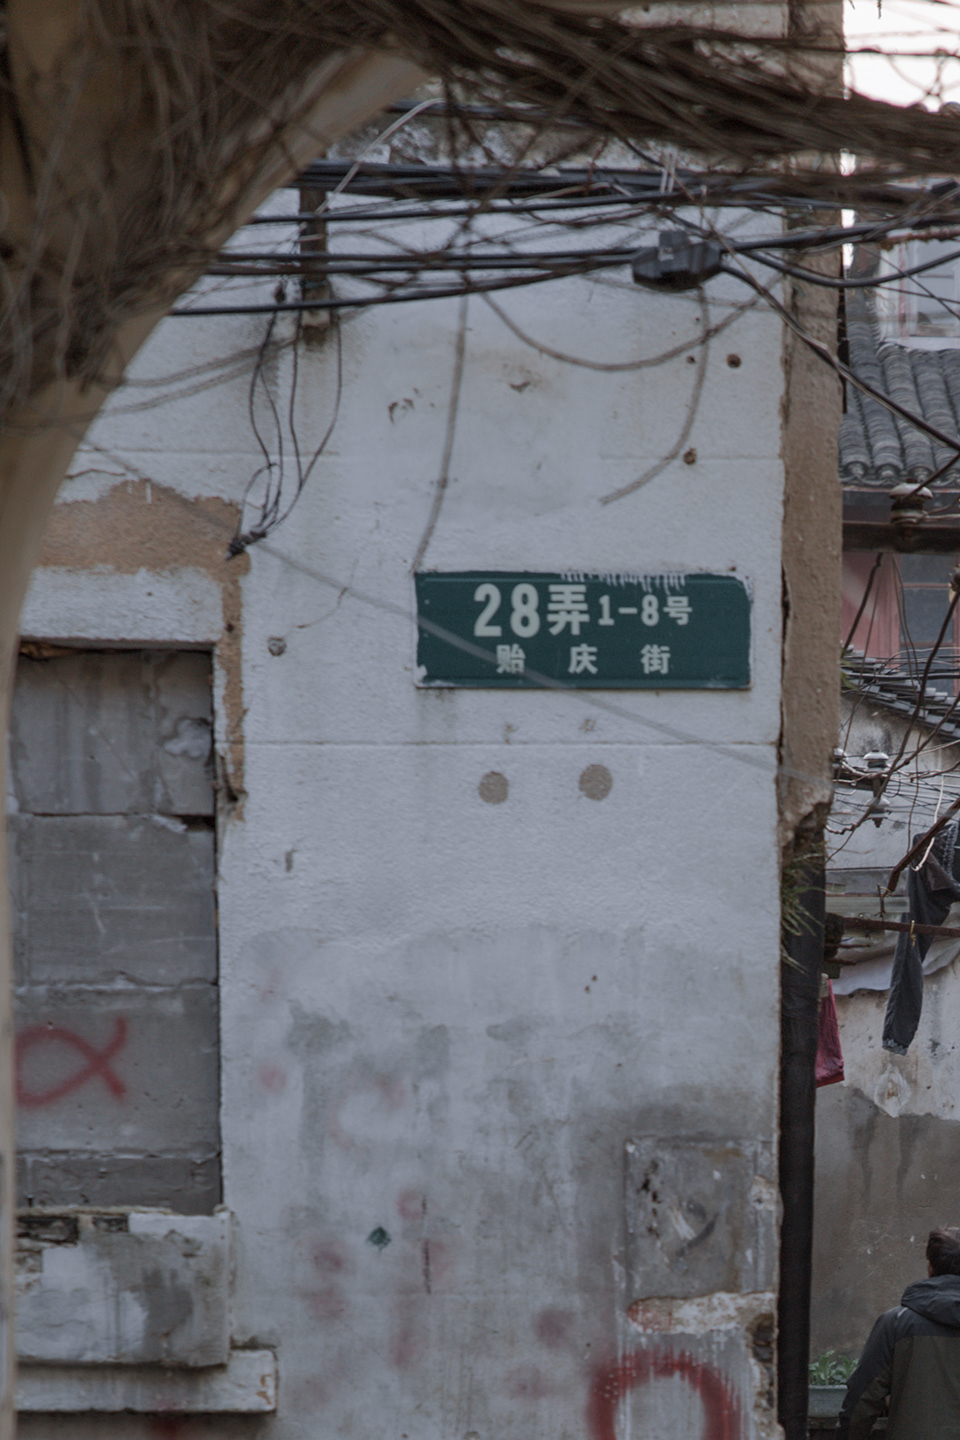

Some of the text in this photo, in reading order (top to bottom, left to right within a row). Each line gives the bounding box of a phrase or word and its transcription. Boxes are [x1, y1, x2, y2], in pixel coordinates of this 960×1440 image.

[473, 583, 693, 638] 28弄1-8号
[495, 643, 672, 675] 贻庆街
